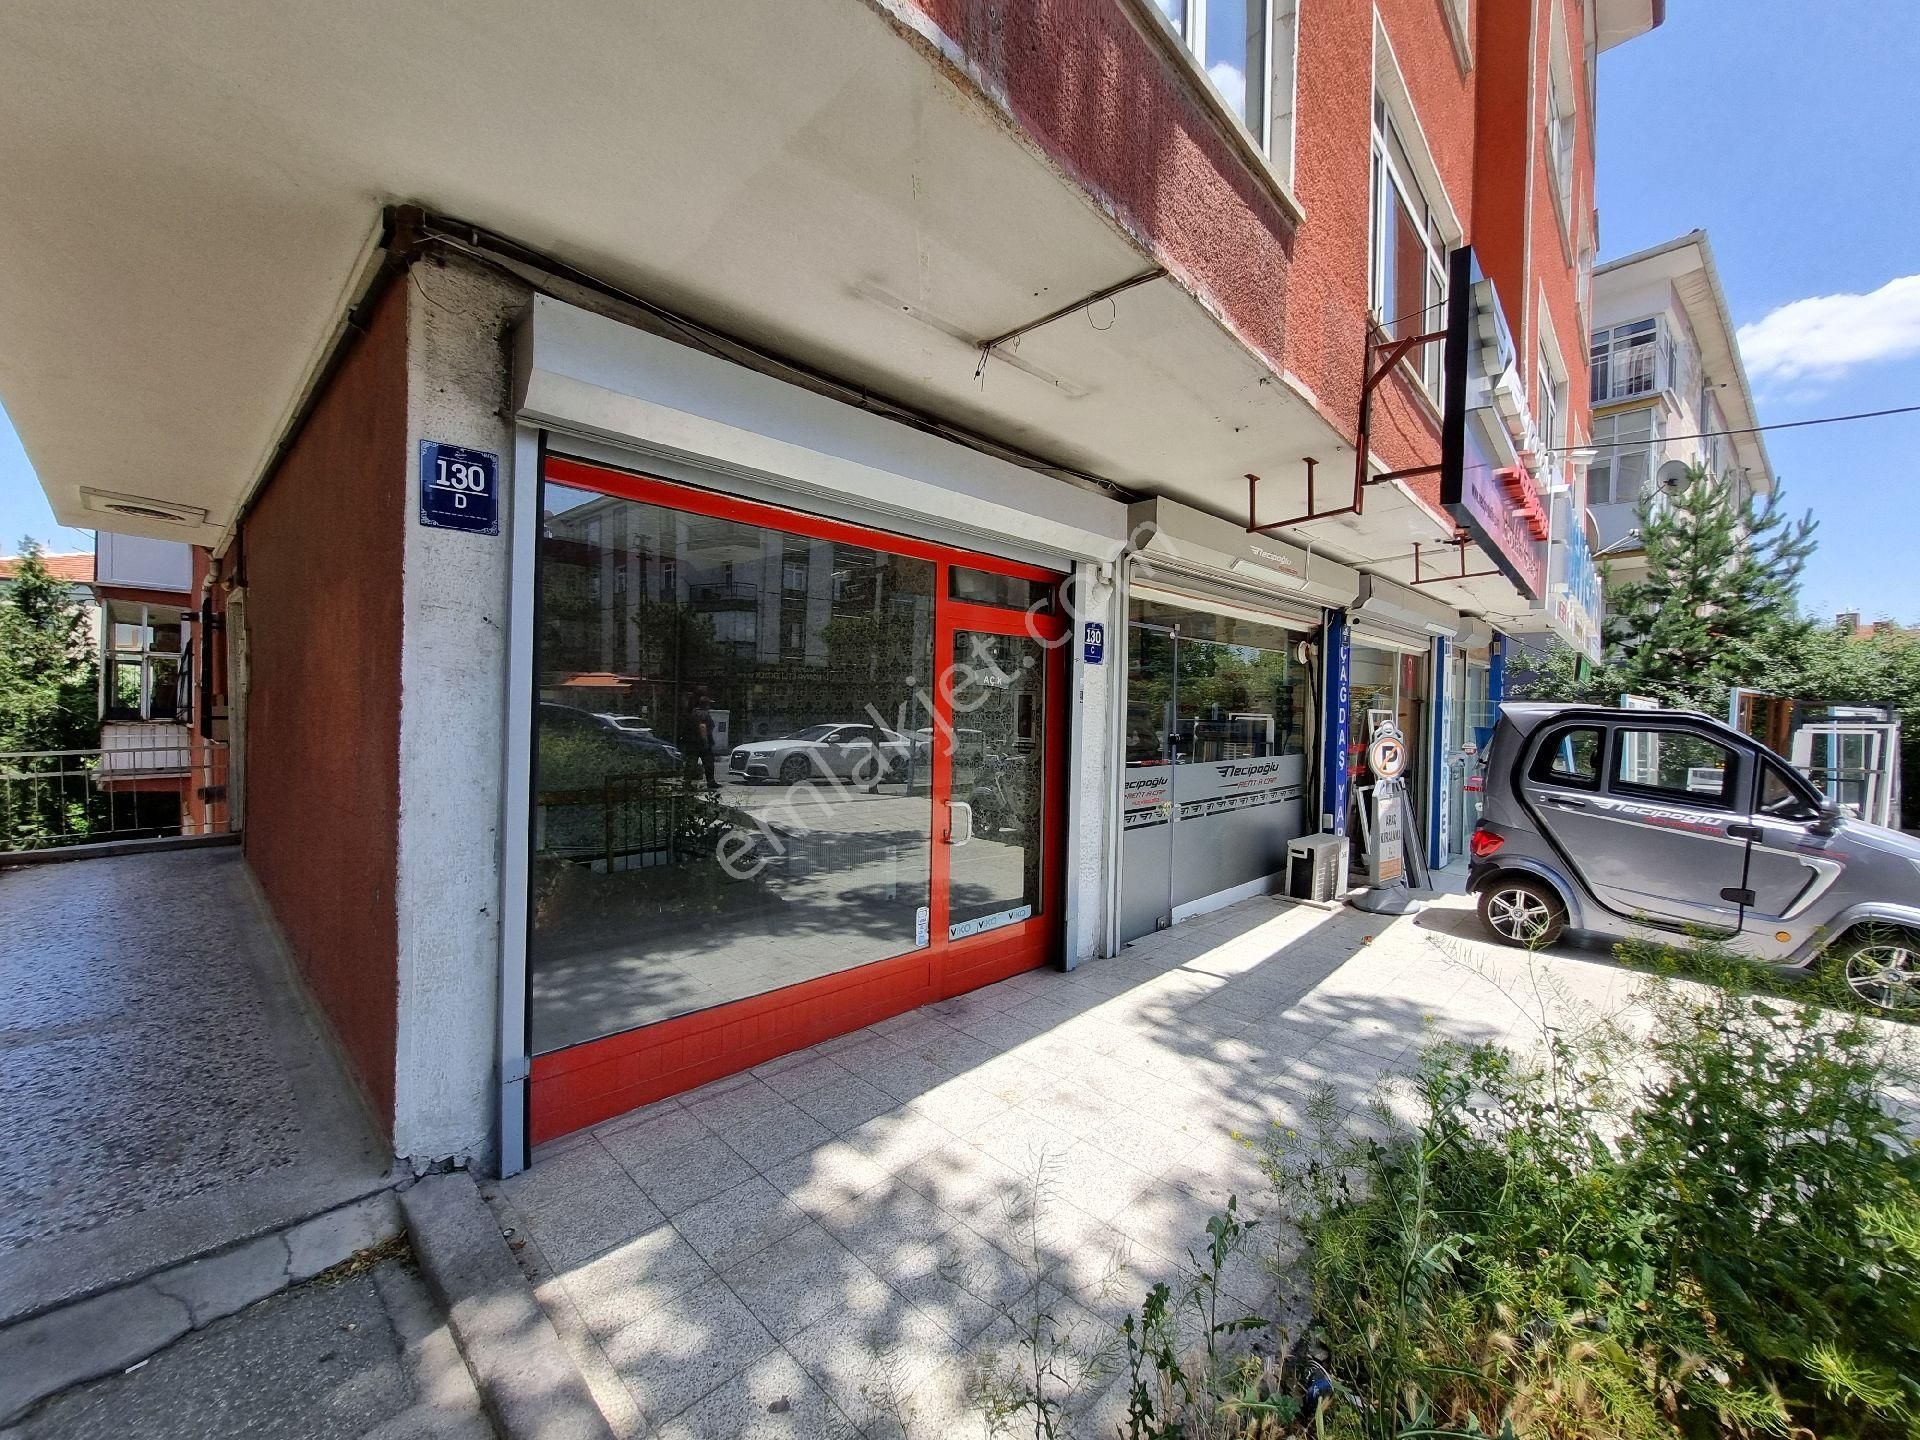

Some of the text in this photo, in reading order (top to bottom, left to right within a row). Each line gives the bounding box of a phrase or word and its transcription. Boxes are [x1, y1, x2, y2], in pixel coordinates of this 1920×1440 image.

[436, 459, 485, 492] 130
[454, 493, 467, 509] D
[1086, 629, 1101, 644] 130
[1090, 646, 1095, 654] C
[983, 675, 1002, 686] AÇK
[1338, 646, 1348, 771] ÇAĞDAŞ
[1125, 777, 1168, 790] ecipoğlu
